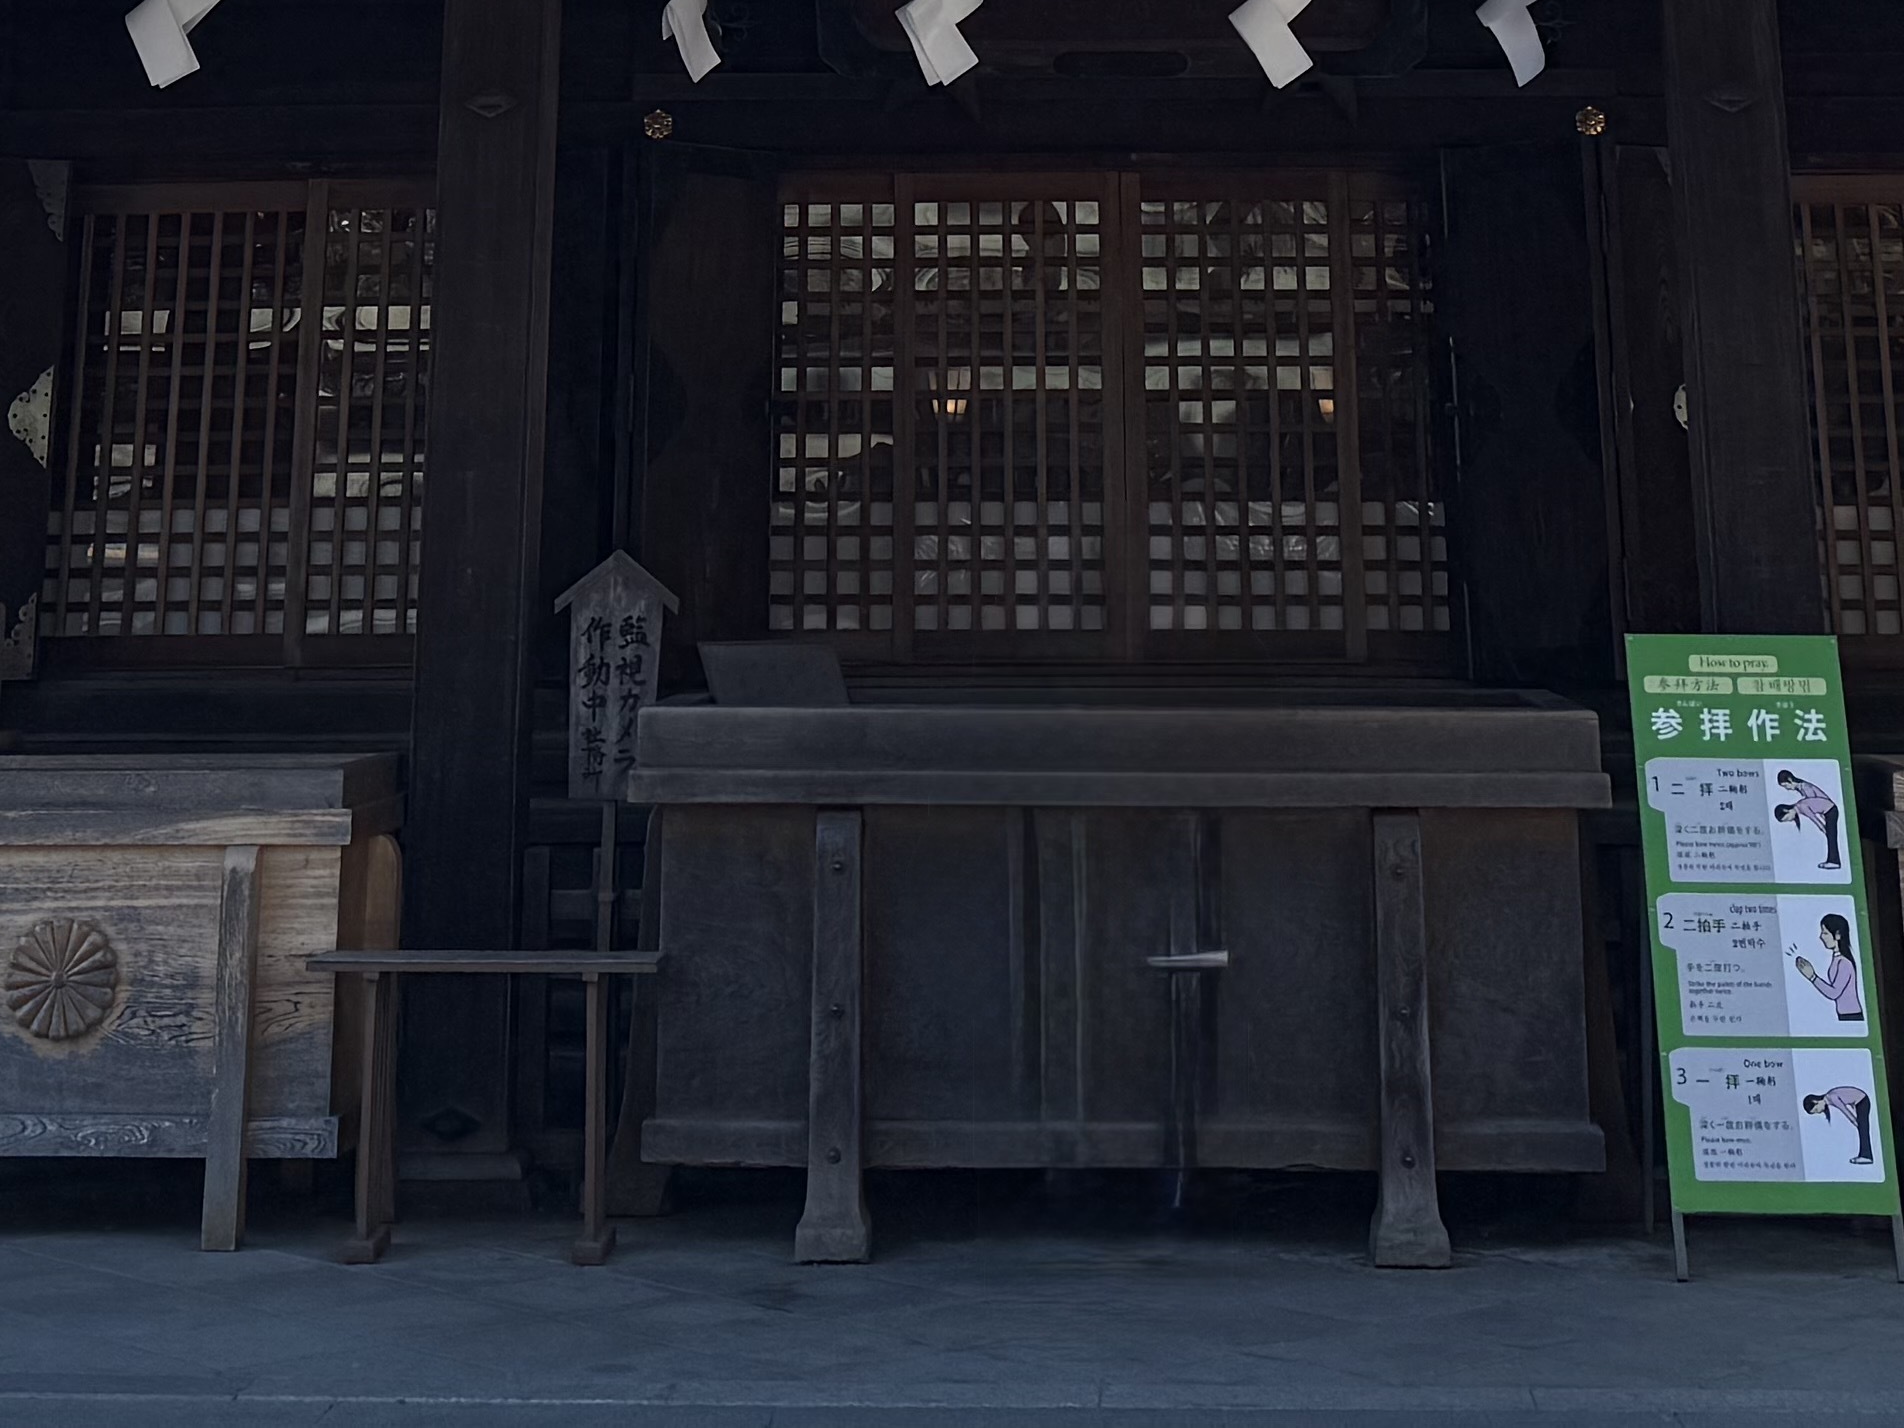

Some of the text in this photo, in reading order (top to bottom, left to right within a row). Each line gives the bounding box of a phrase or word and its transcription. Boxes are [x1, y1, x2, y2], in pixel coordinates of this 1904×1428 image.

[578, 616, 612, 722] 作動中
[1700, 656, 1726, 669] How
[1728, 657, 1741, 669] to
[614, 615, 650, 786] 監視カメラ
[1651, 707, 1827, 742] 参拝作法
[1717, 769, 1760, 778] Two bows
[1651, 776, 1659, 792] 1
[1745, 905, 1757, 914] two
[1663, 912, 1674, 929] 2
[1683, 918, 1726, 933] 二拍手
[1744, 1058, 1783, 1068] One bow
[1676, 1067, 1687, 1085] 3
